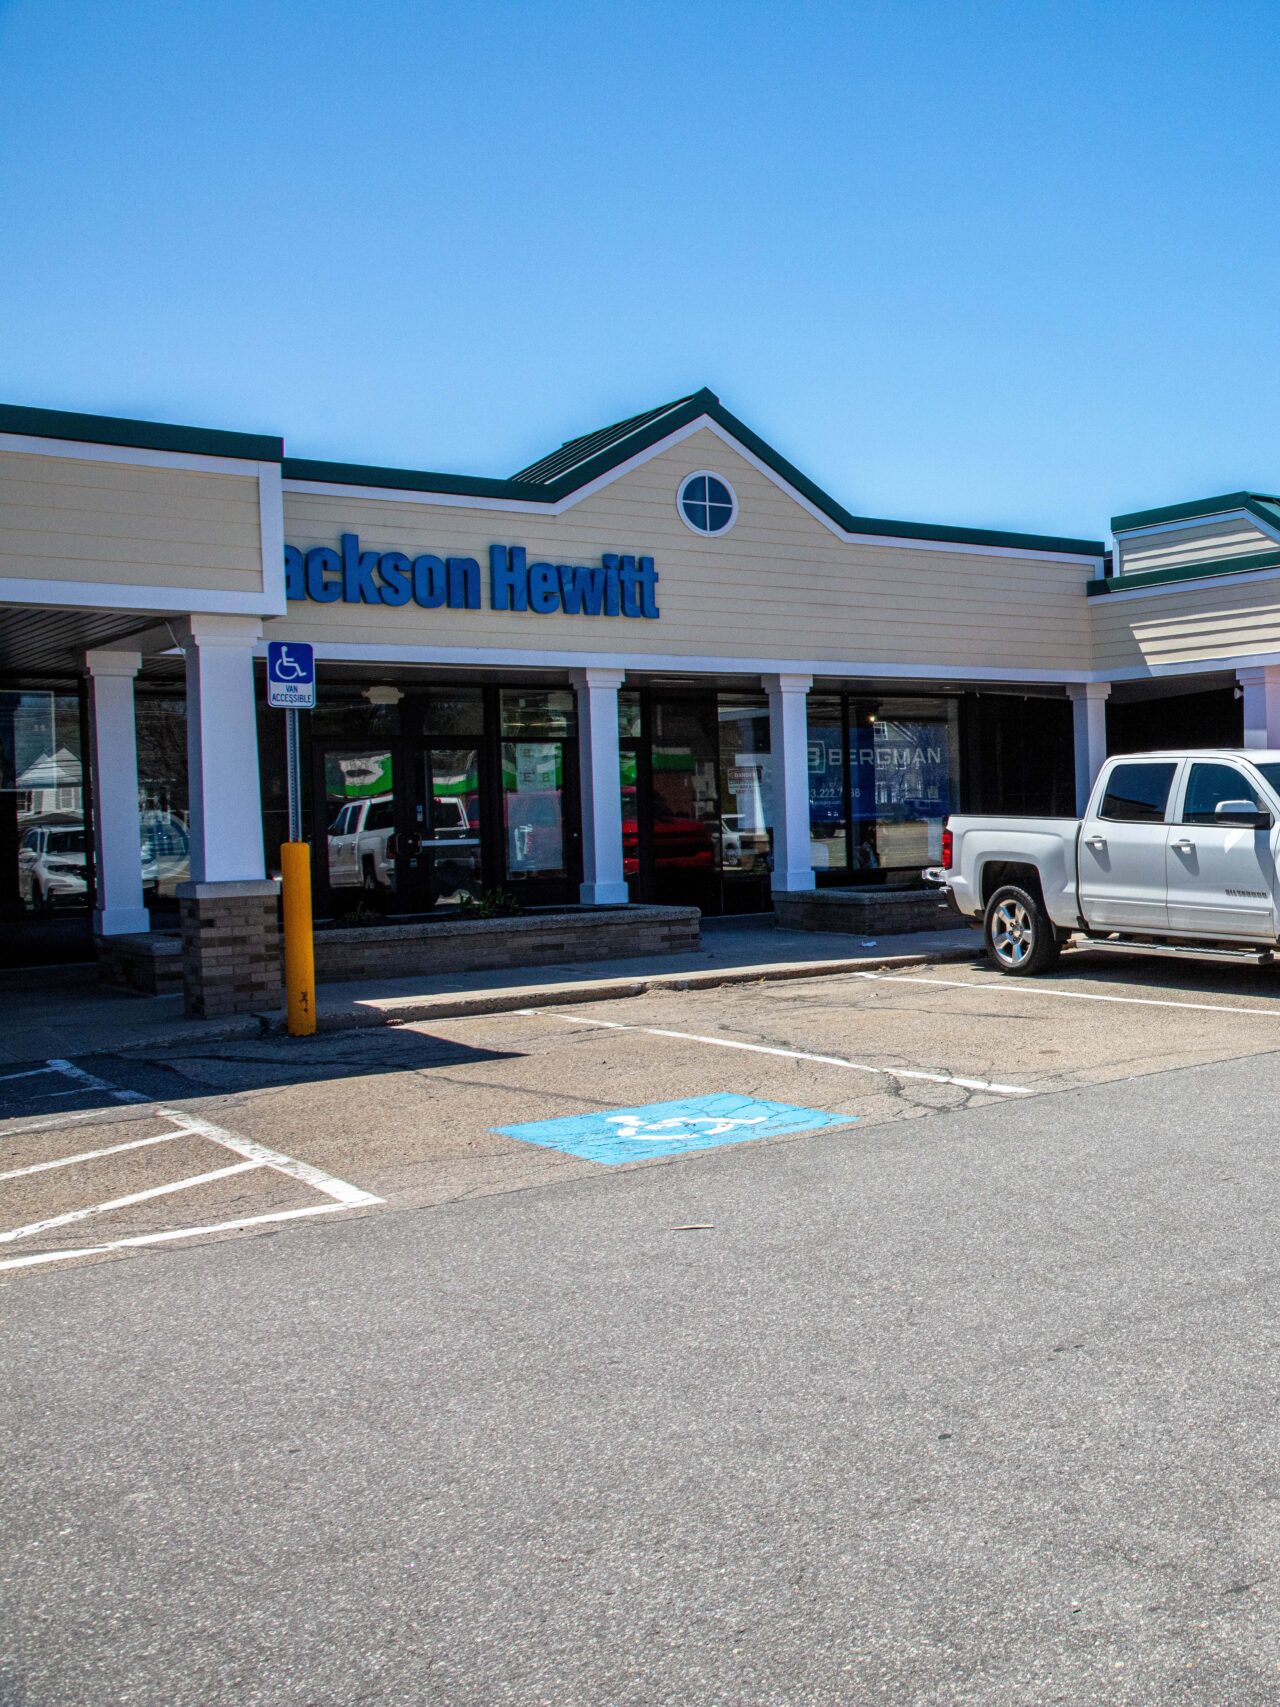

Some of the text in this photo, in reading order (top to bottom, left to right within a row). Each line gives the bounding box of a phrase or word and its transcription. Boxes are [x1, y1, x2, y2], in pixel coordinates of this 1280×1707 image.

[285, 534, 660, 619] ackson Hewitt
[286, 685, 298, 693] VAN
[272, 694, 312, 703] ACCESSIBLE
[828, 747, 942, 766] BERGMAN
